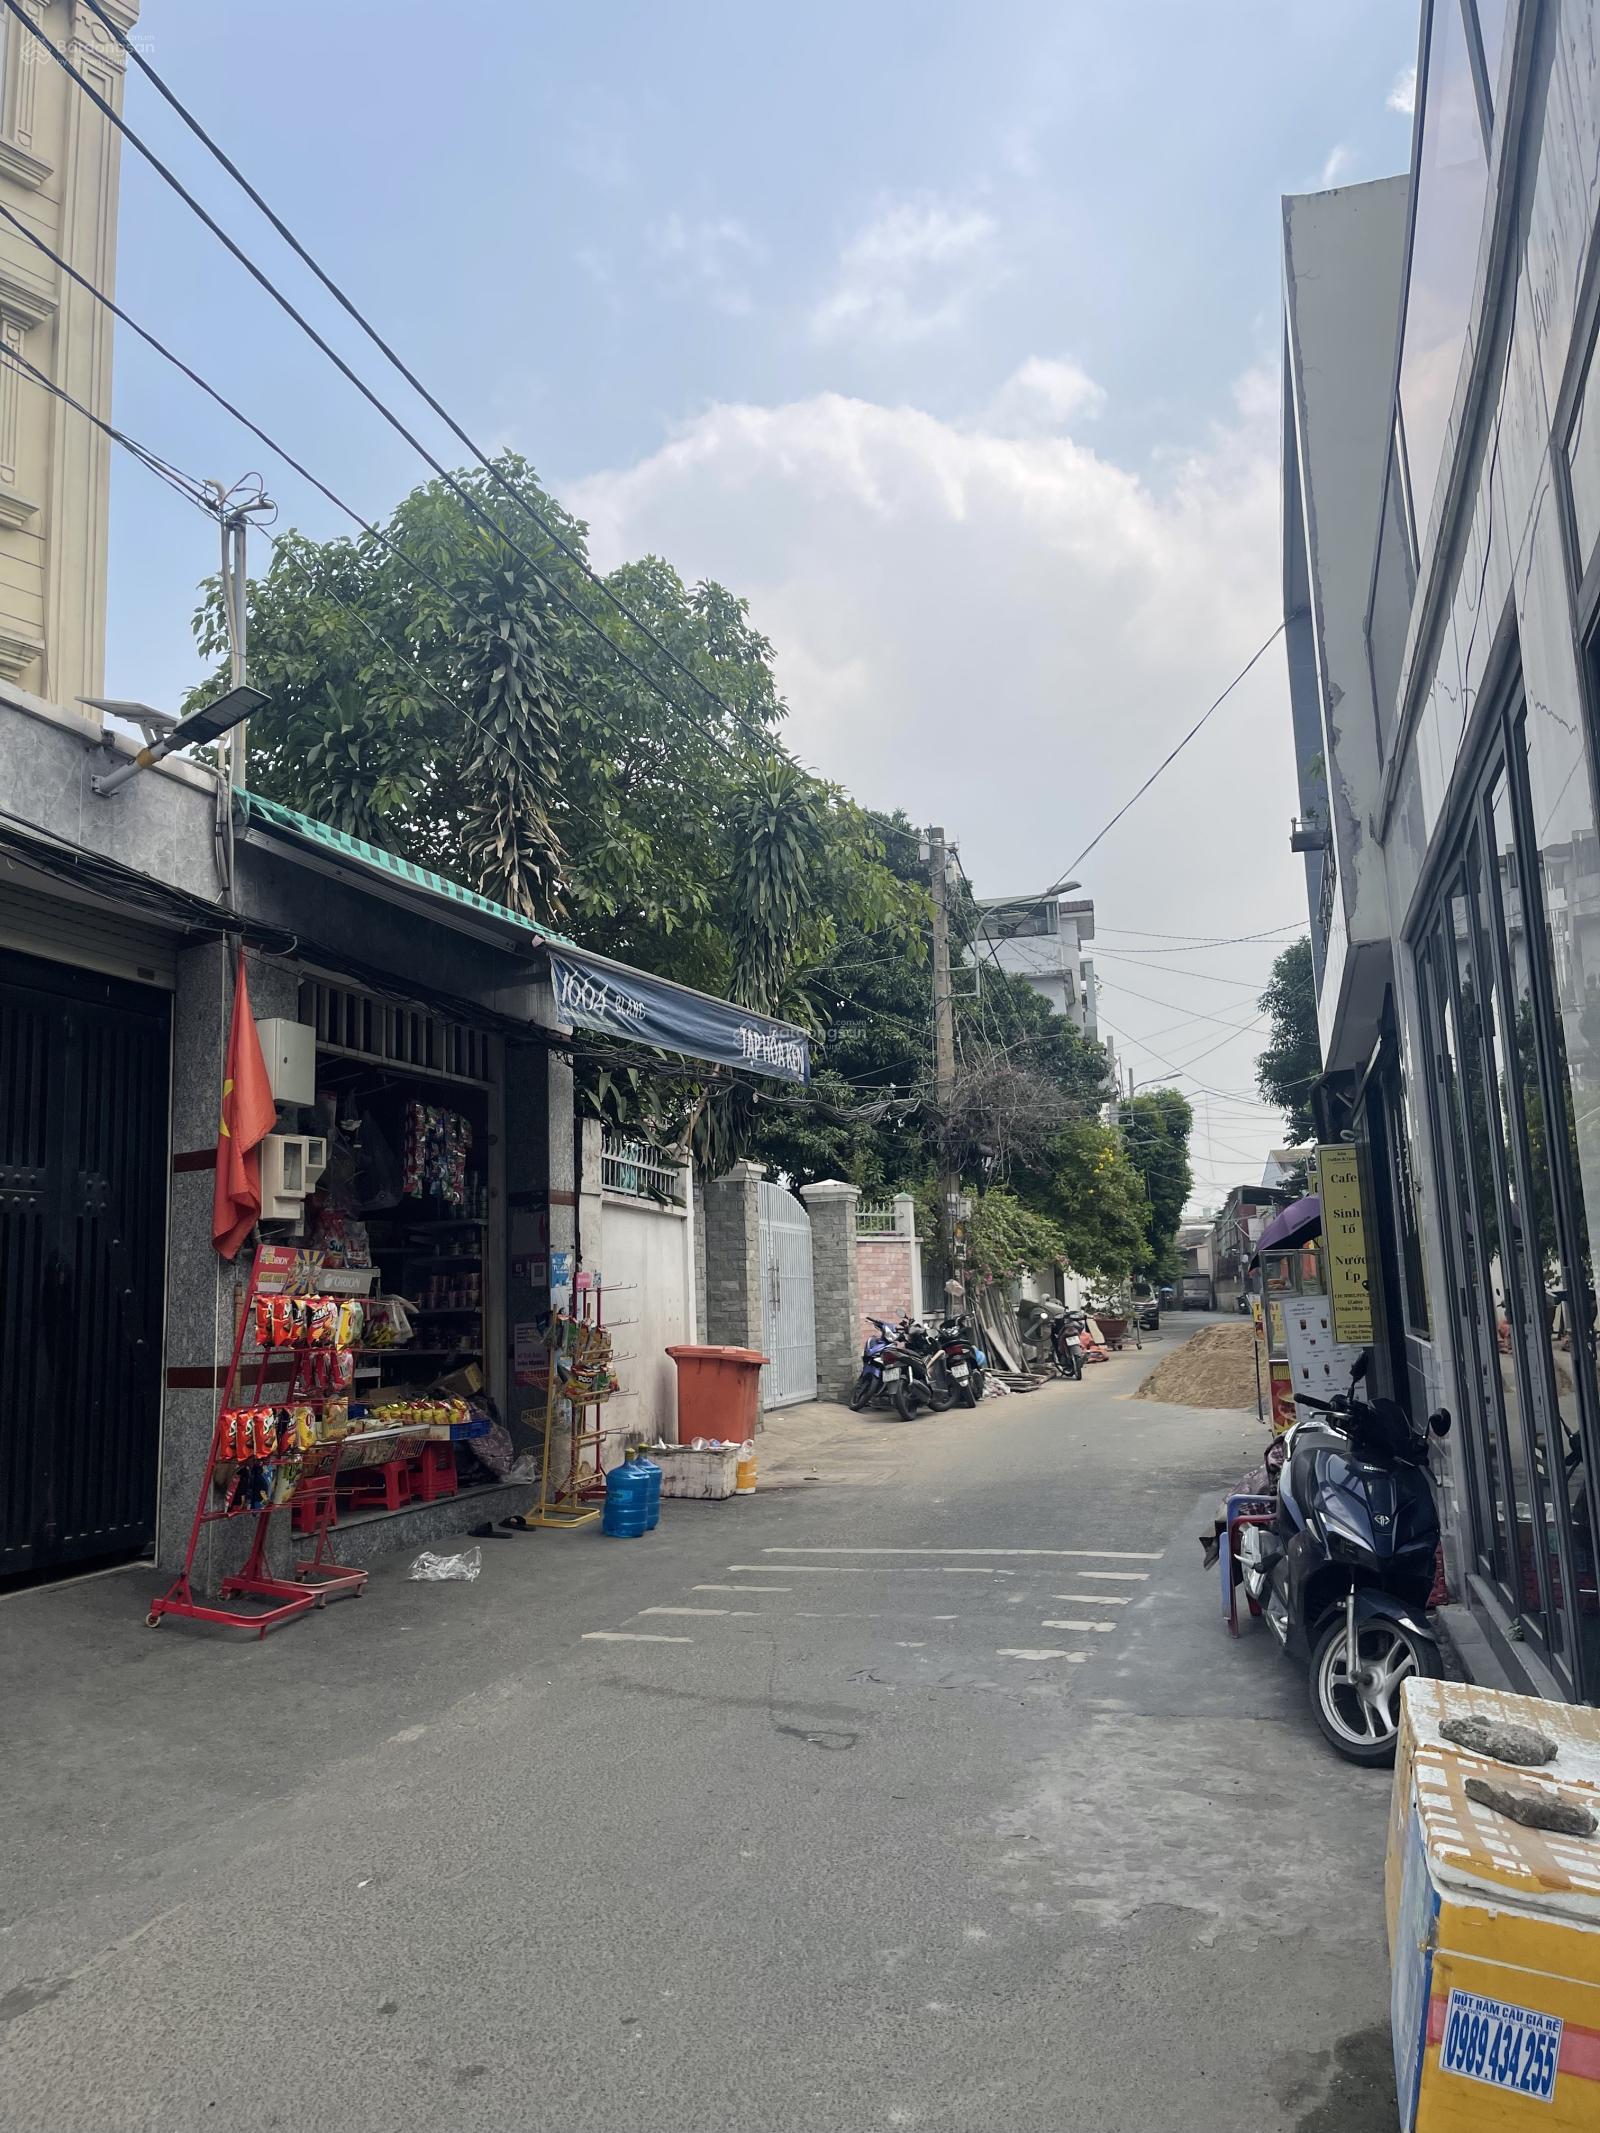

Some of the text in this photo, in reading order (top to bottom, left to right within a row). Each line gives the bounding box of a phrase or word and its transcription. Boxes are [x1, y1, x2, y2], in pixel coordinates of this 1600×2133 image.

[1330, 1172, 1357, 1184] Cafe
[1333, 1208, 1361, 1219] Sinh
[1341, 1222, 1356, 1234] Tố
[1345, 1267, 1361, 1283] Ép
[334, 1276, 360, 1288] ORION
[1453, 1993, 1475, 2007] HÚT
[1525, 2013, 1544, 2028] GIÁ
[1545, 2018, 1561, 2033] RẺ
[1446, 2009, 1557, 2096] 0989.434.255
